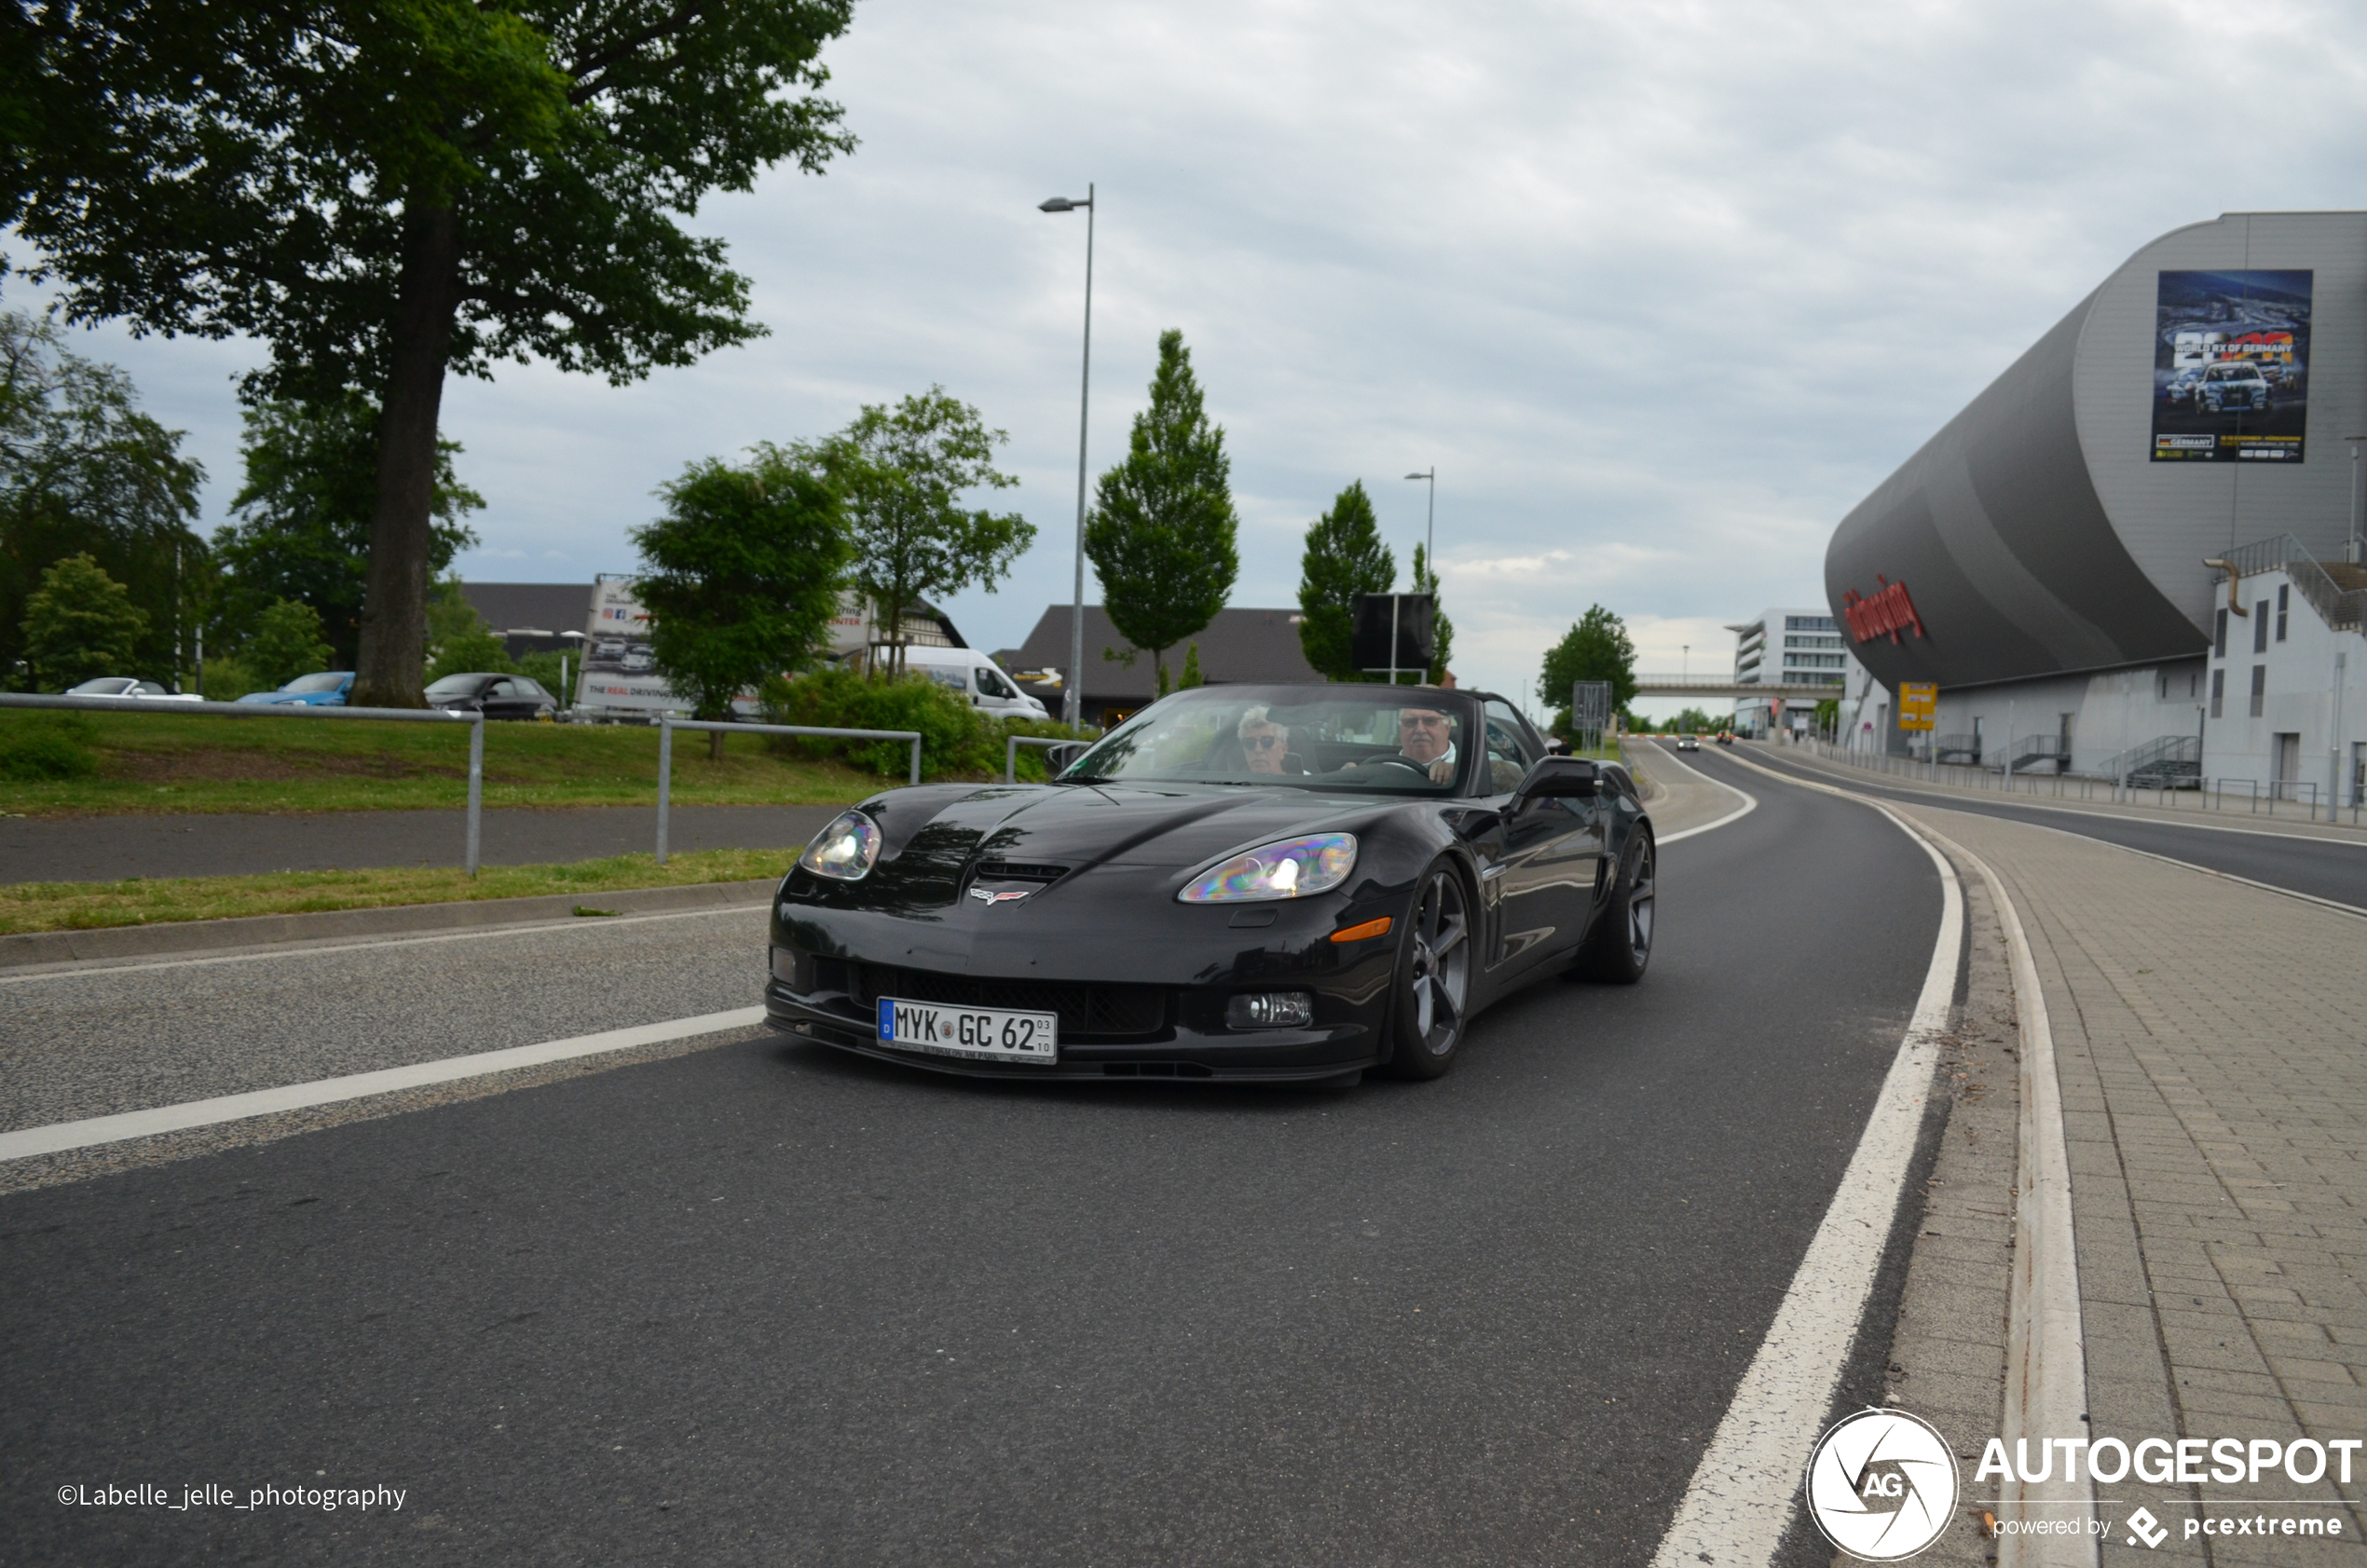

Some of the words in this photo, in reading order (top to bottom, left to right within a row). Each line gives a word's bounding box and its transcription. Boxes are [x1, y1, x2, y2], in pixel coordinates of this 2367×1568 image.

[2176, 344, 2210, 353] WORLD
[2211, 344, 2226, 353] RX
[2228, 344, 2241, 353] OF
[2242, 344, 2292, 353] GERMANY
[589, 685, 605, 694] THE
[608, 686, 628, 696] REAL
[883, 1024, 890, 1033] D
[895, 1006, 938, 1042] MYK
[959, 1014, 992, 1046] GC
[1002, 1017, 1034, 1051] 62
[1037, 1019, 1050, 1029] 03
[1037, 1043, 1049, 1052] 10
[978, 1053, 999, 1061] PARK
